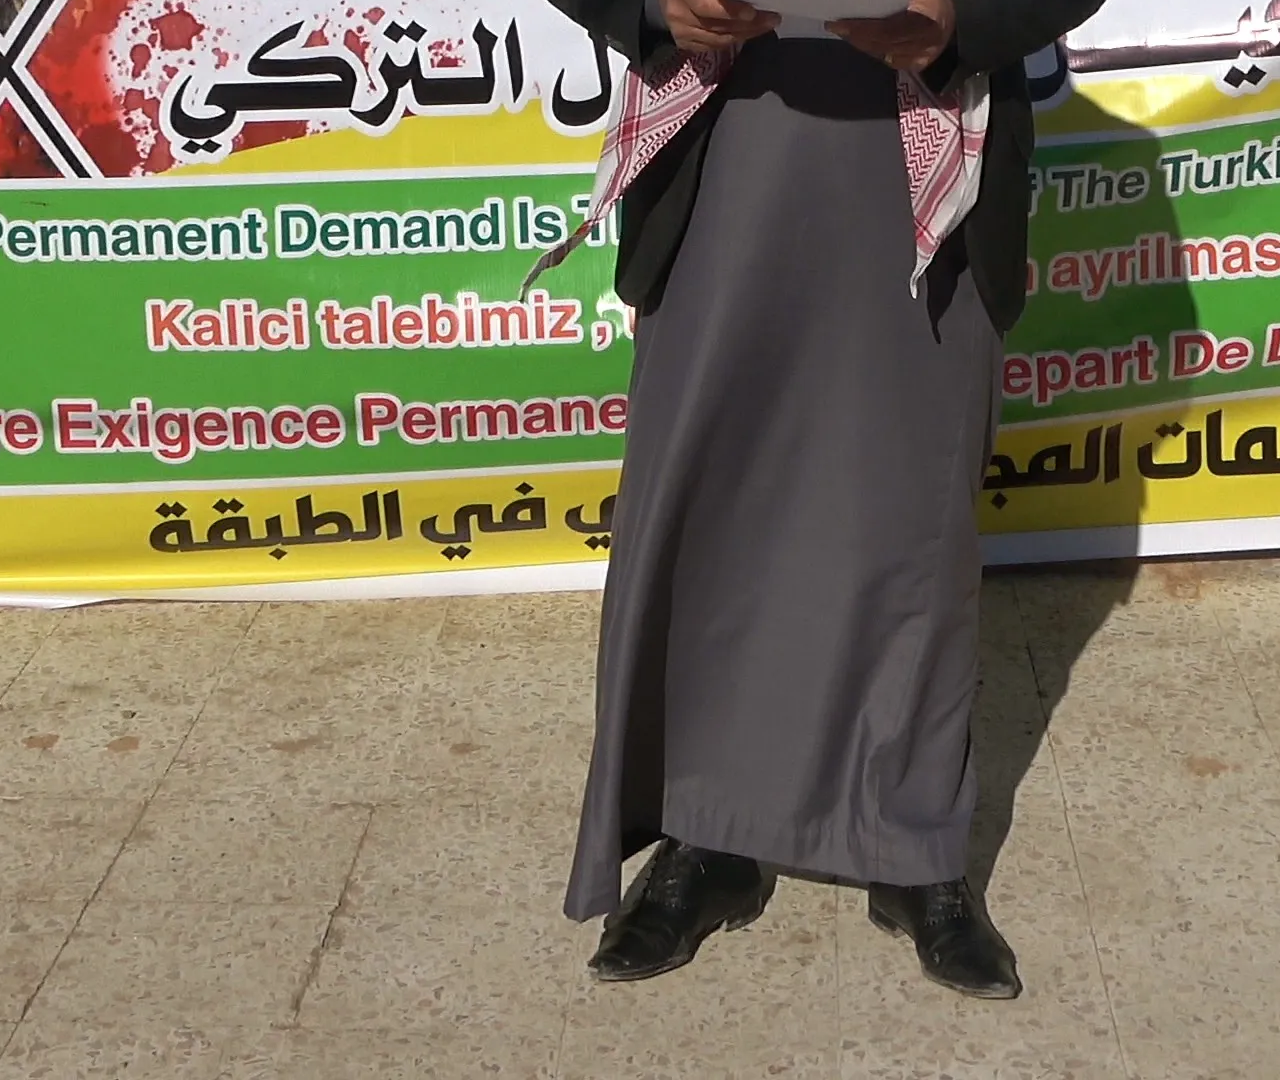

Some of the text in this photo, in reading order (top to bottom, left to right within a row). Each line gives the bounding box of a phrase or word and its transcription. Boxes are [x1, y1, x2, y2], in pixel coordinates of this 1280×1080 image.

[168, 17, 523, 155] التركي
[1052, 169, 1146, 207] The
[280, 201, 501, 251] Demand
[520, 203, 568, 245] Is
[150, 303, 306, 348] Kalici
[1002, 340, 1154, 404] epart
[1173, 333, 1249, 377] De
[57, 399, 342, 460] Exigence
[361, 396, 628, 442] Permane
[149, 489, 400, 561] الطبقة
[419, 482, 548, 561] في
